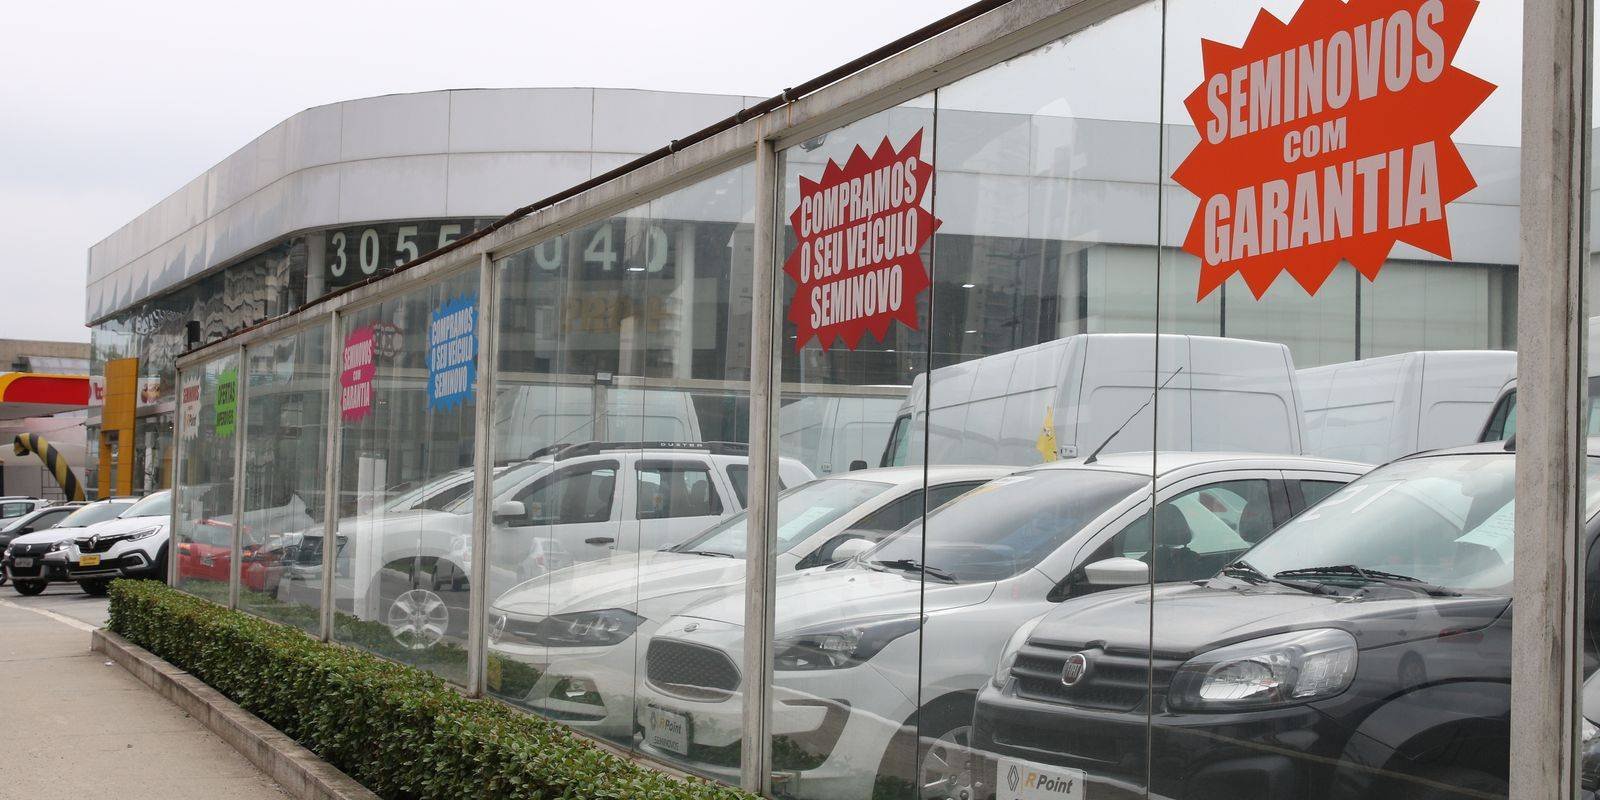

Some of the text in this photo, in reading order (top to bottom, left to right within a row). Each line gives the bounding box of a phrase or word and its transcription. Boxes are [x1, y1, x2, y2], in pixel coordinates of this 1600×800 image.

[1206, 0, 1445, 145] SEMINOVOS
[1283, 117, 1347, 163] COM
[801, 156, 917, 238] COMPRAMOS
[1204, 140, 1442, 267] GARANTIA
[801, 207, 918, 284] O SEU VEÍCULO
[811, 264, 902, 330] SEMINOVO
[432, 306, 473, 346] COMPRAMOS
[435, 366, 468, 399] SEMINOVO
[436, 343, 447, 371] SEU
[343, 381, 370, 411] GARANTIA
